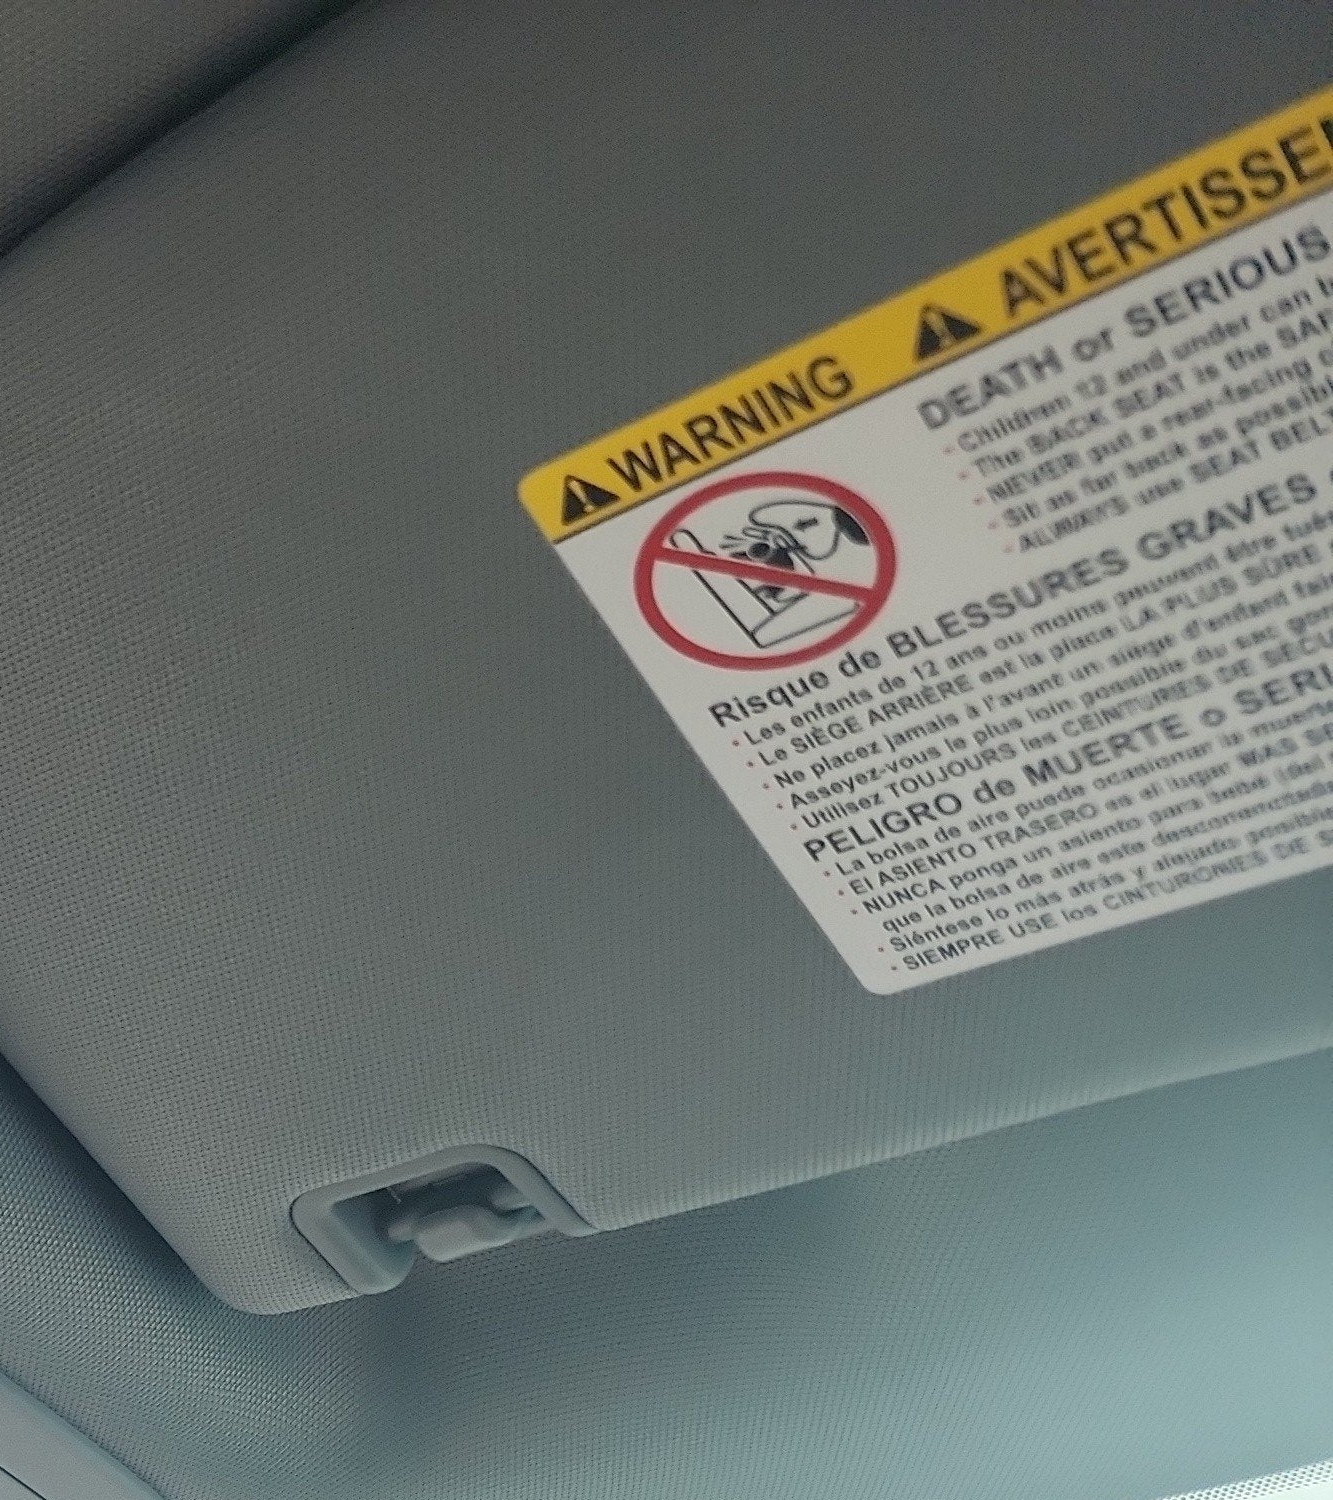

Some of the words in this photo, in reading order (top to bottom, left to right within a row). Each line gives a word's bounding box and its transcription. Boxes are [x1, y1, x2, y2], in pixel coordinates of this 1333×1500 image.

[1000, 116, 1333, 317] AVERTISSE
[918, 346, 1062, 429] DEATH
[1071, 327, 1113, 362] or
[1125, 227, 1332, 336] SERIOUS
[957, 396, 1070, 451] Children
[1114, 348, 1166, 386] and
[1172, 314, 1250, 361] under
[1259, 289, 1312, 323] can
[607, 355, 853, 490] WARNING
[972, 448, 1024, 476] The
[1026, 409, 1107, 454] BACK
[1113, 371, 1184, 418] SEAT
[1193, 364, 1220, 384] is
[1223, 342, 1271, 370] the
[1139, 424, 1157, 441] a
[1161, 358, 1313, 430] rear-facing
[1197, 427, 1228, 449] as
[1189, 438, 1259, 482] SEAT
[708, 670, 829, 727] Risque
[837, 650, 881, 677] de
[887, 549, 1127, 657] BLESSURES
[1138, 473, 1316, 559] GRAVES
[742, 721, 786, 745] Les
[790, 688, 873, 727] enfants
[877, 675, 906, 694] de
[910, 658, 940, 681] 12
[946, 645, 988, 669] ans
[993, 631, 1025, 650] ou
[757, 747, 788, 766] Le
[790, 715, 862, 753] SIÈGE
[867, 674, 972, 725] ARRIÈRE
[978, 659, 1016, 684] est
[773, 769, 805, 788] Ne
[809, 740, 881, 779] placez
[883, 712, 959, 752] jamais
[790, 746, 941, 809] Asseyez-vous
[943, 736, 967, 753] le
[972, 716, 1023, 747] plus
[1025, 698, 1073, 722] loin
[801, 792, 883, 828] Utilisez
[884, 742, 1016, 797] TOUJOURS
[1019, 731, 1057, 752] les
[803, 792, 962, 861] PELIGRO
[972, 778, 1016, 804] de
[1022, 714, 1187, 785] MUERTE
[1199, 706, 1227, 728] o
[1234, 663, 1333, 714] SERI
[834, 858, 866, 876] La
[866, 836, 929, 865] bolsa
[933, 825, 961, 843] de
[967, 809, 1009, 832] aire
[1014, 784, 1086, 819] puede
[848, 876, 874, 895] El
[878, 842, 976, 886] ASIENTO
[981, 802, 1098, 849] TRASERO
[862, 878, 945, 913] NUNCA
[948, 856, 1018, 890] ponga
[1022, 845, 1052, 863] un
[1058, 817, 1142, 851] asiento
[882, 911, 922, 933] que
[923, 903, 947, 917] la
[948, 882, 1011, 909] bolsa
[1015, 872, 1043, 889] de
[1050, 857, 1091, 879] aire
[889, 915, 982, 951] Siéntese
[984, 907, 1010, 922] lo
[1014, 890, 1062, 913] más
[1068, 871, 1125, 897] atrás
[902, 929, 1003, 970] SIEMPRE
[1007, 912, 1057, 938] USE
[1060, 903, 1098, 922] los
